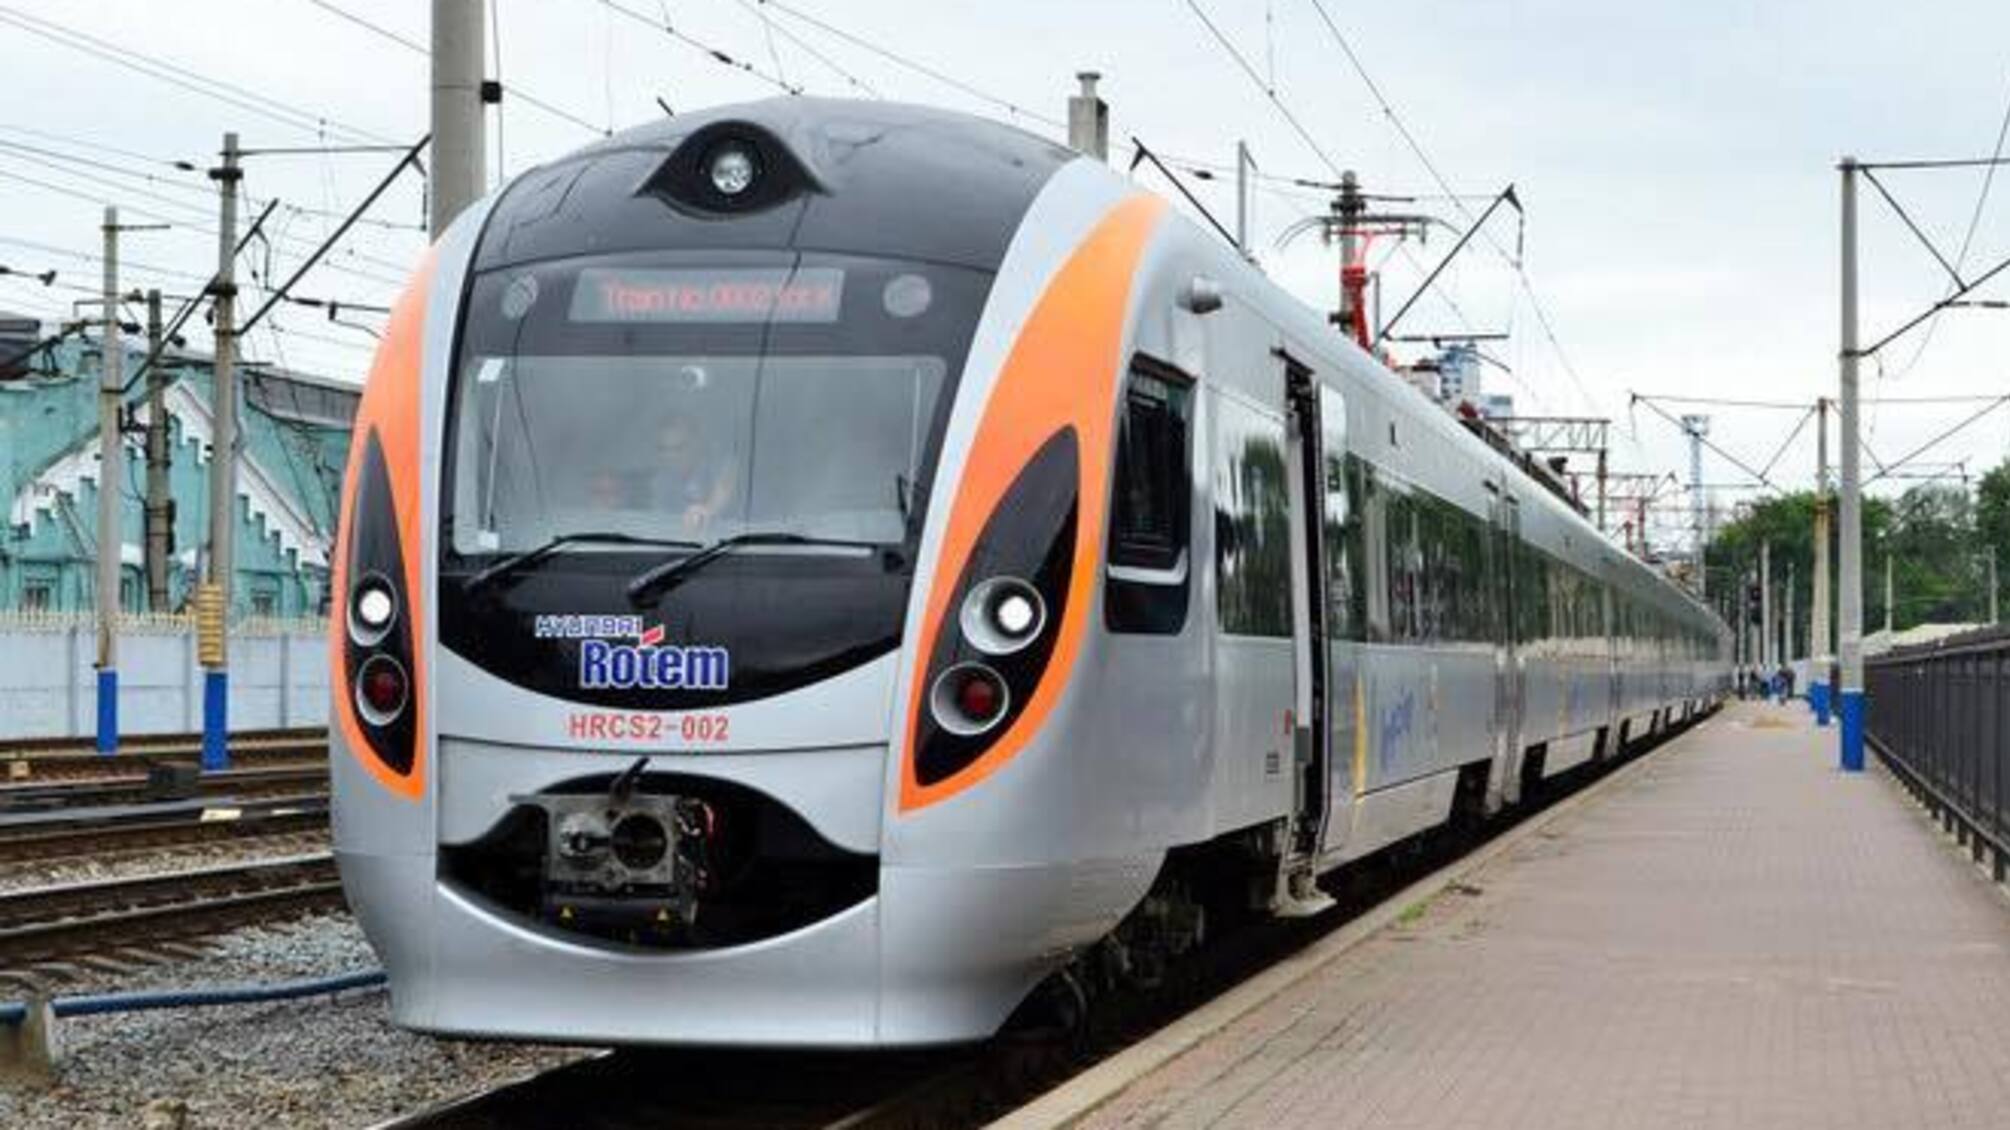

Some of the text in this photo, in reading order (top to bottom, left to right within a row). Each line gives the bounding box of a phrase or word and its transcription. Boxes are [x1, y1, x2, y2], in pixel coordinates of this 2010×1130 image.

[535, 615, 643, 637] HYUNDAI
[580, 636, 728, 689] Rotem
[568, 713, 729, 741] HRCS2-002
